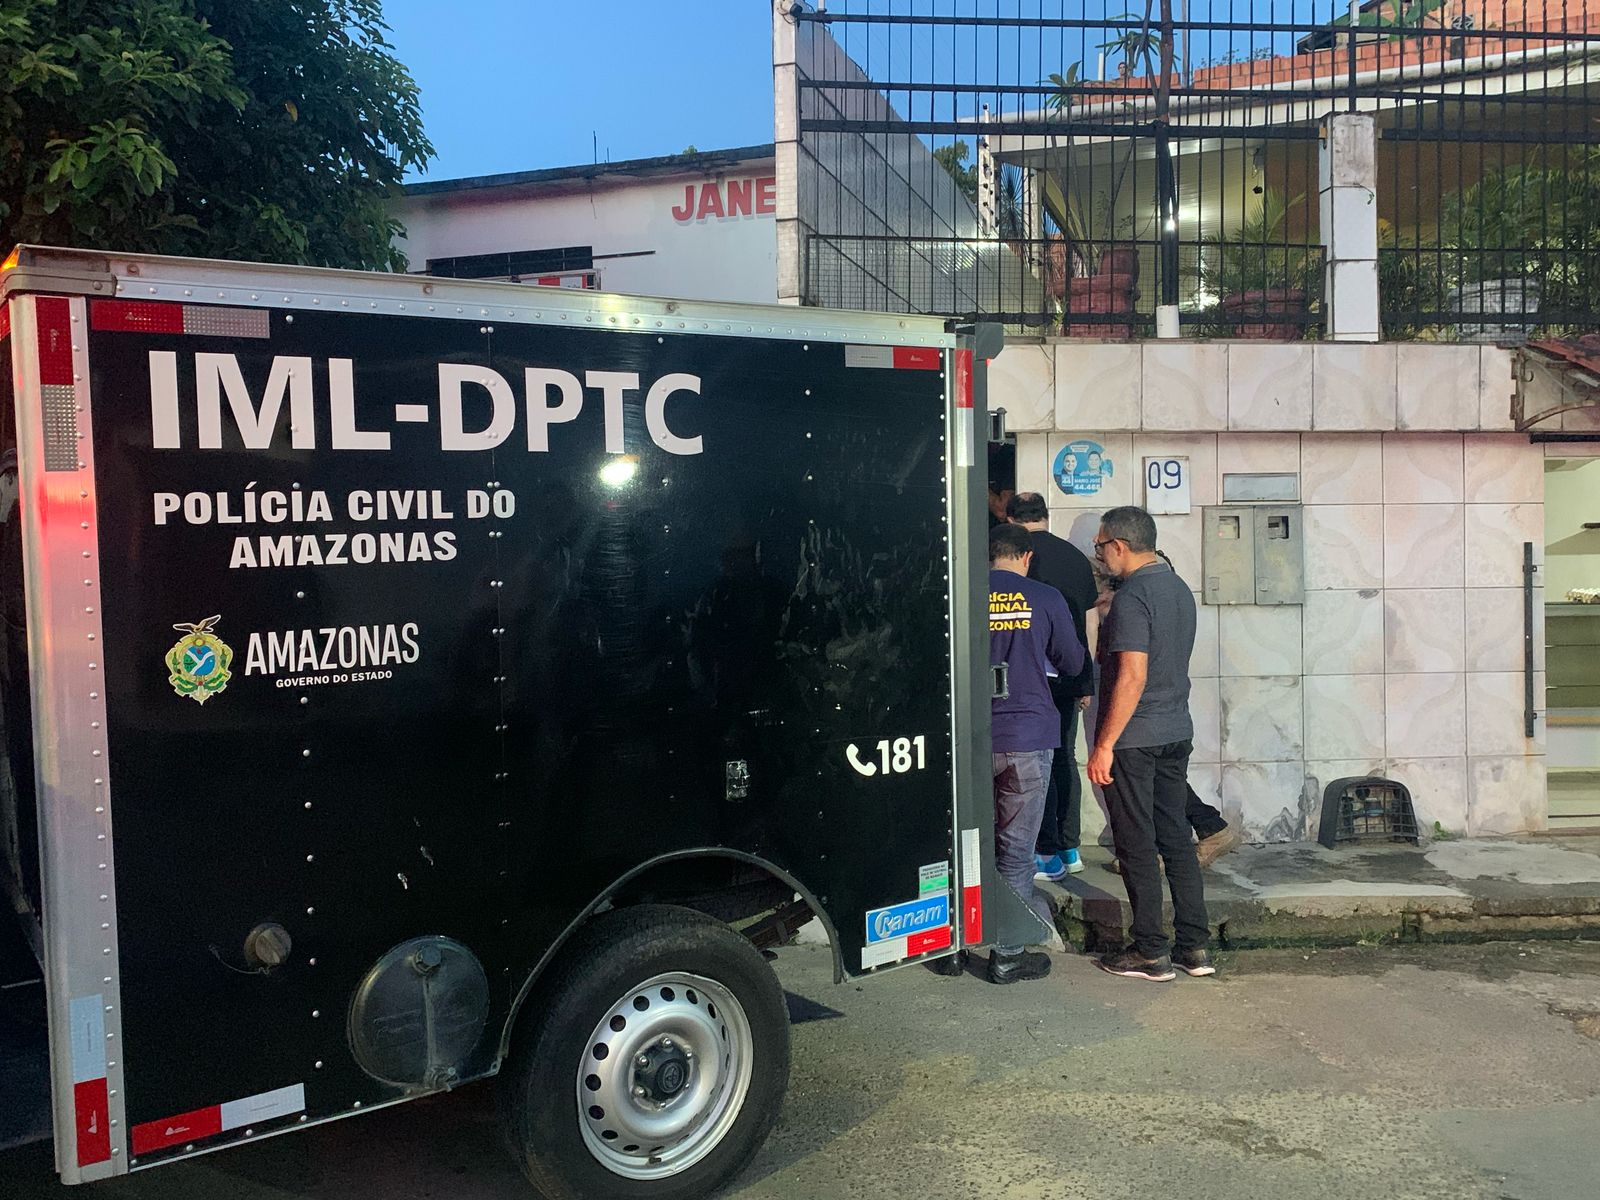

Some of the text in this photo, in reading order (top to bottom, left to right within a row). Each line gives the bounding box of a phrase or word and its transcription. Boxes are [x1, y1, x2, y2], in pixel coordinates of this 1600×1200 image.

[671, 177, 776, 221] JANE
[149, 350, 704, 456] IML-DPTC
[1148, 460, 1182, 490] 09
[153, 481, 516, 526] POLÍCIA CIVIL DO
[229, 530, 458, 569] AMAZONAS
[244, 622, 420, 676] AMAZONAS
[275, 670, 393, 688] GOVERNO DO ESTADO
[876, 735, 925, 775] 181
